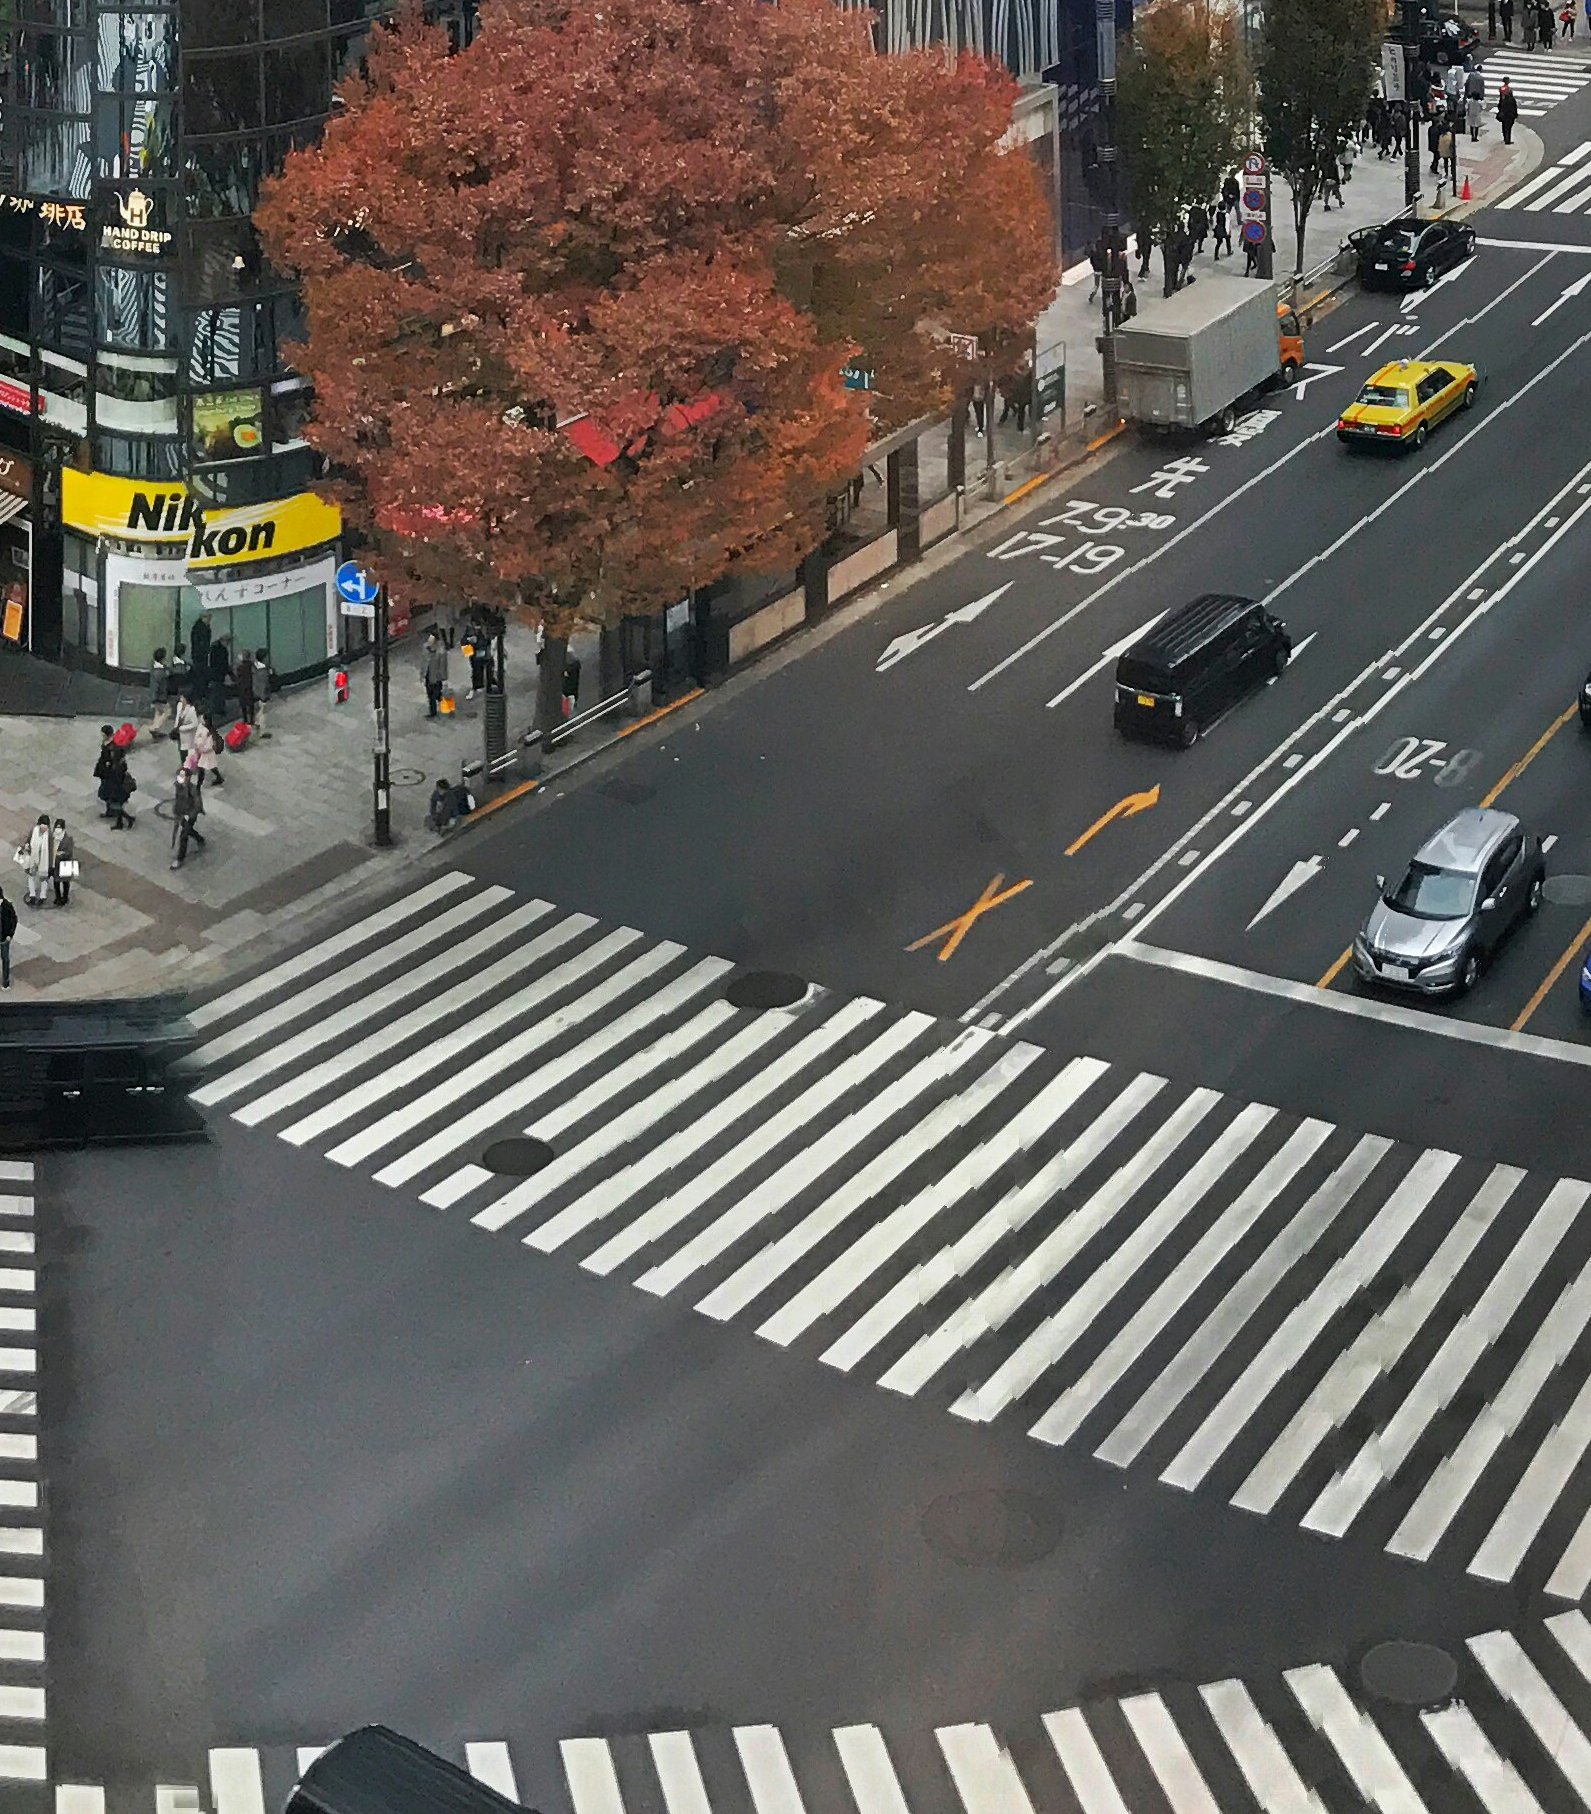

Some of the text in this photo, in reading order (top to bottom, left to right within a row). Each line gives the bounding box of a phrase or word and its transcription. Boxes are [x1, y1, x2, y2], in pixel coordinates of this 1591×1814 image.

[103, 225, 172, 243] HAND DRIP
[113, 239, 160, 254] COFFEE
[1038, 500, 1177, 534] 7-9:30
[986, 531, 1126, 574] 17-19
